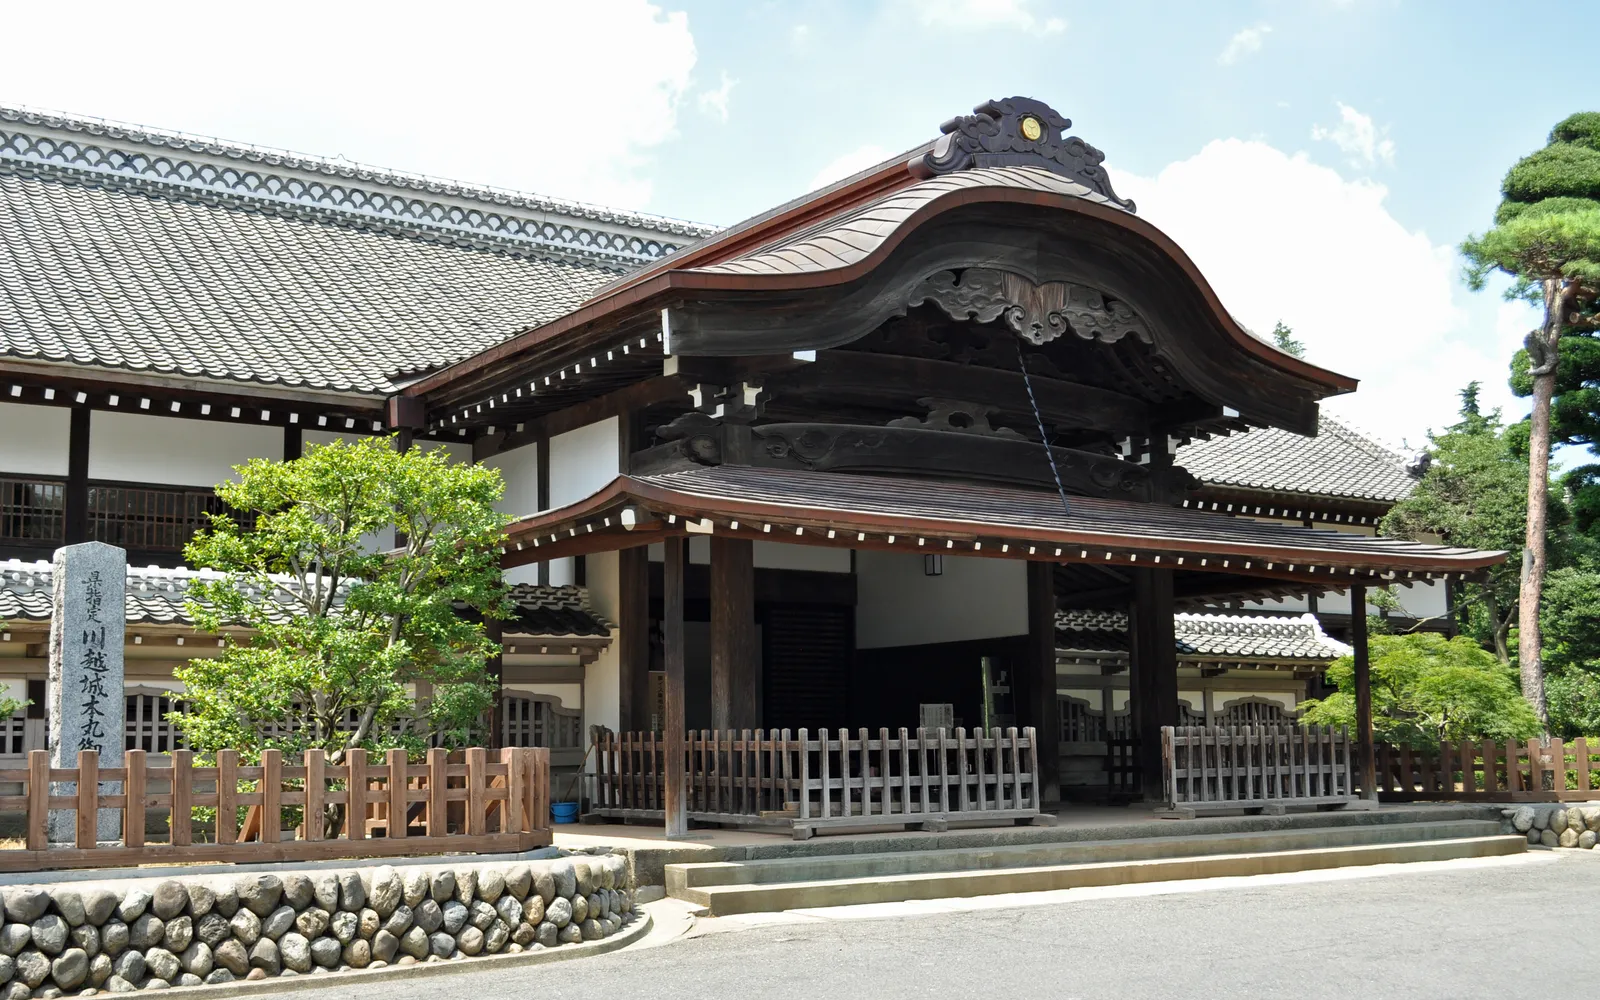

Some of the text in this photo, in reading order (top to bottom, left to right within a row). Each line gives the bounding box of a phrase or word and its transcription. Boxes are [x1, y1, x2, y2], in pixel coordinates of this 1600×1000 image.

[77, 571, 109, 786] 県指定川越城本丸御
